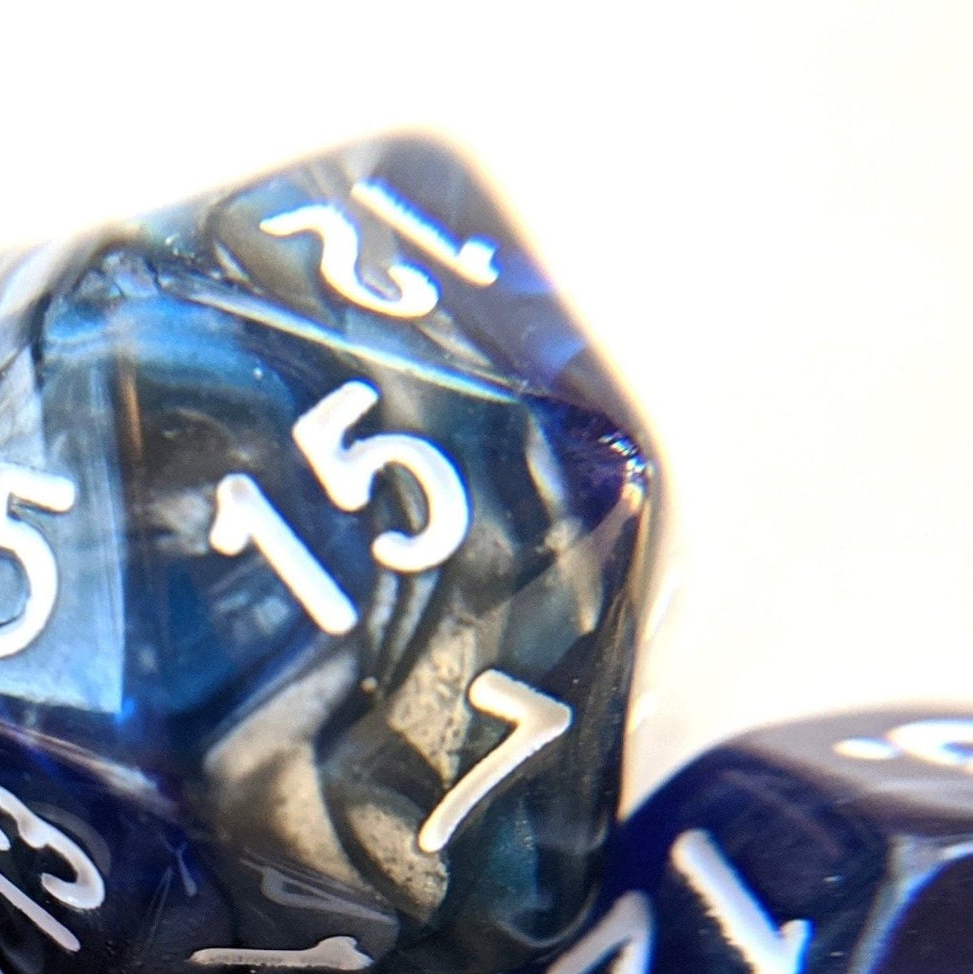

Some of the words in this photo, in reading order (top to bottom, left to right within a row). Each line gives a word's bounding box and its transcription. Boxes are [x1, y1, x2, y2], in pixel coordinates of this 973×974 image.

[261, 179, 501, 317] 12
[208, 383, 468, 635] 15
[418, 668, 572, 853] 7
